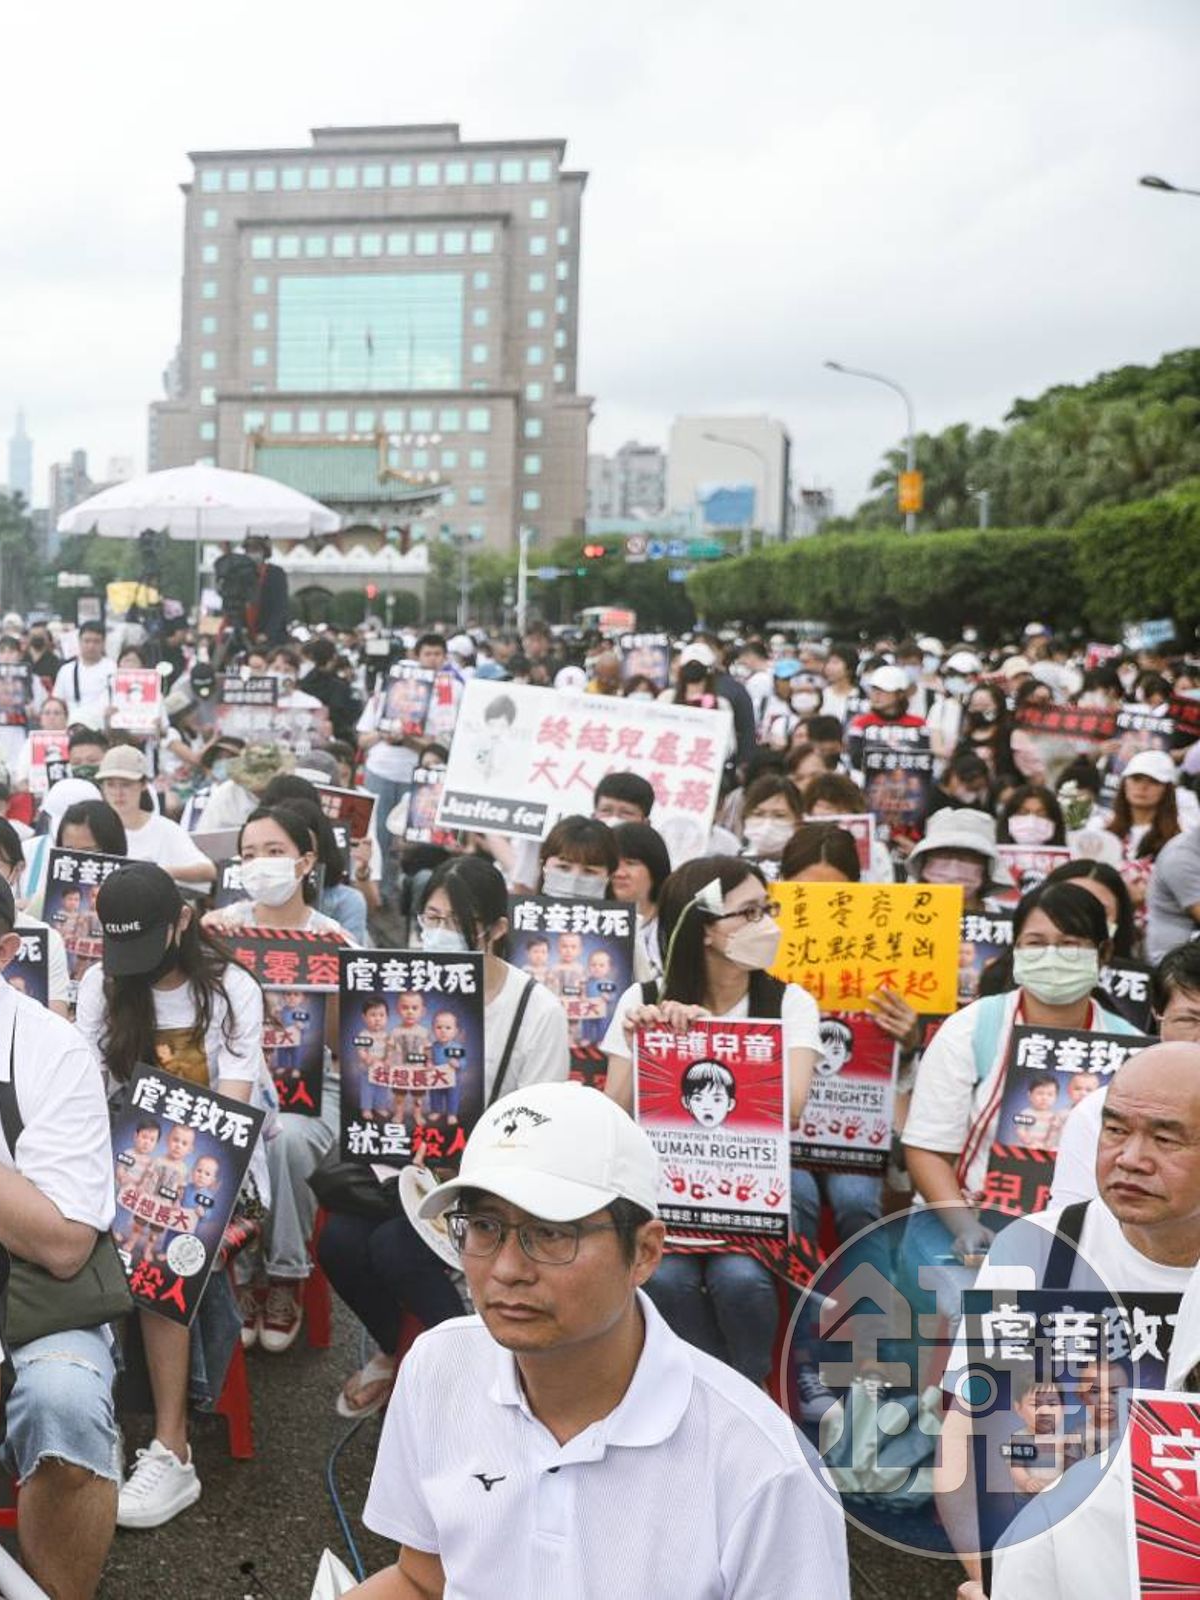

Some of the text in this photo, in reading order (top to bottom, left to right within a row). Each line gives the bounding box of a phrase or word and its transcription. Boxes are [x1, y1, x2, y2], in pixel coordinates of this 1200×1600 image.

[528, 756, 713, 814] 大人義務
[105, 920, 142, 934] CELINE
[345, 957, 477, 994] 虐童致死
[643, 1030, 776, 1064] 守護兒童
[1016, 1033, 1143, 1075] 虐童致
[131, 1075, 254, 1148] 虐童致死
[710, 1144, 777, 1162] RIGHTS!
[980, 1303, 1177, 1362] 虐童致
